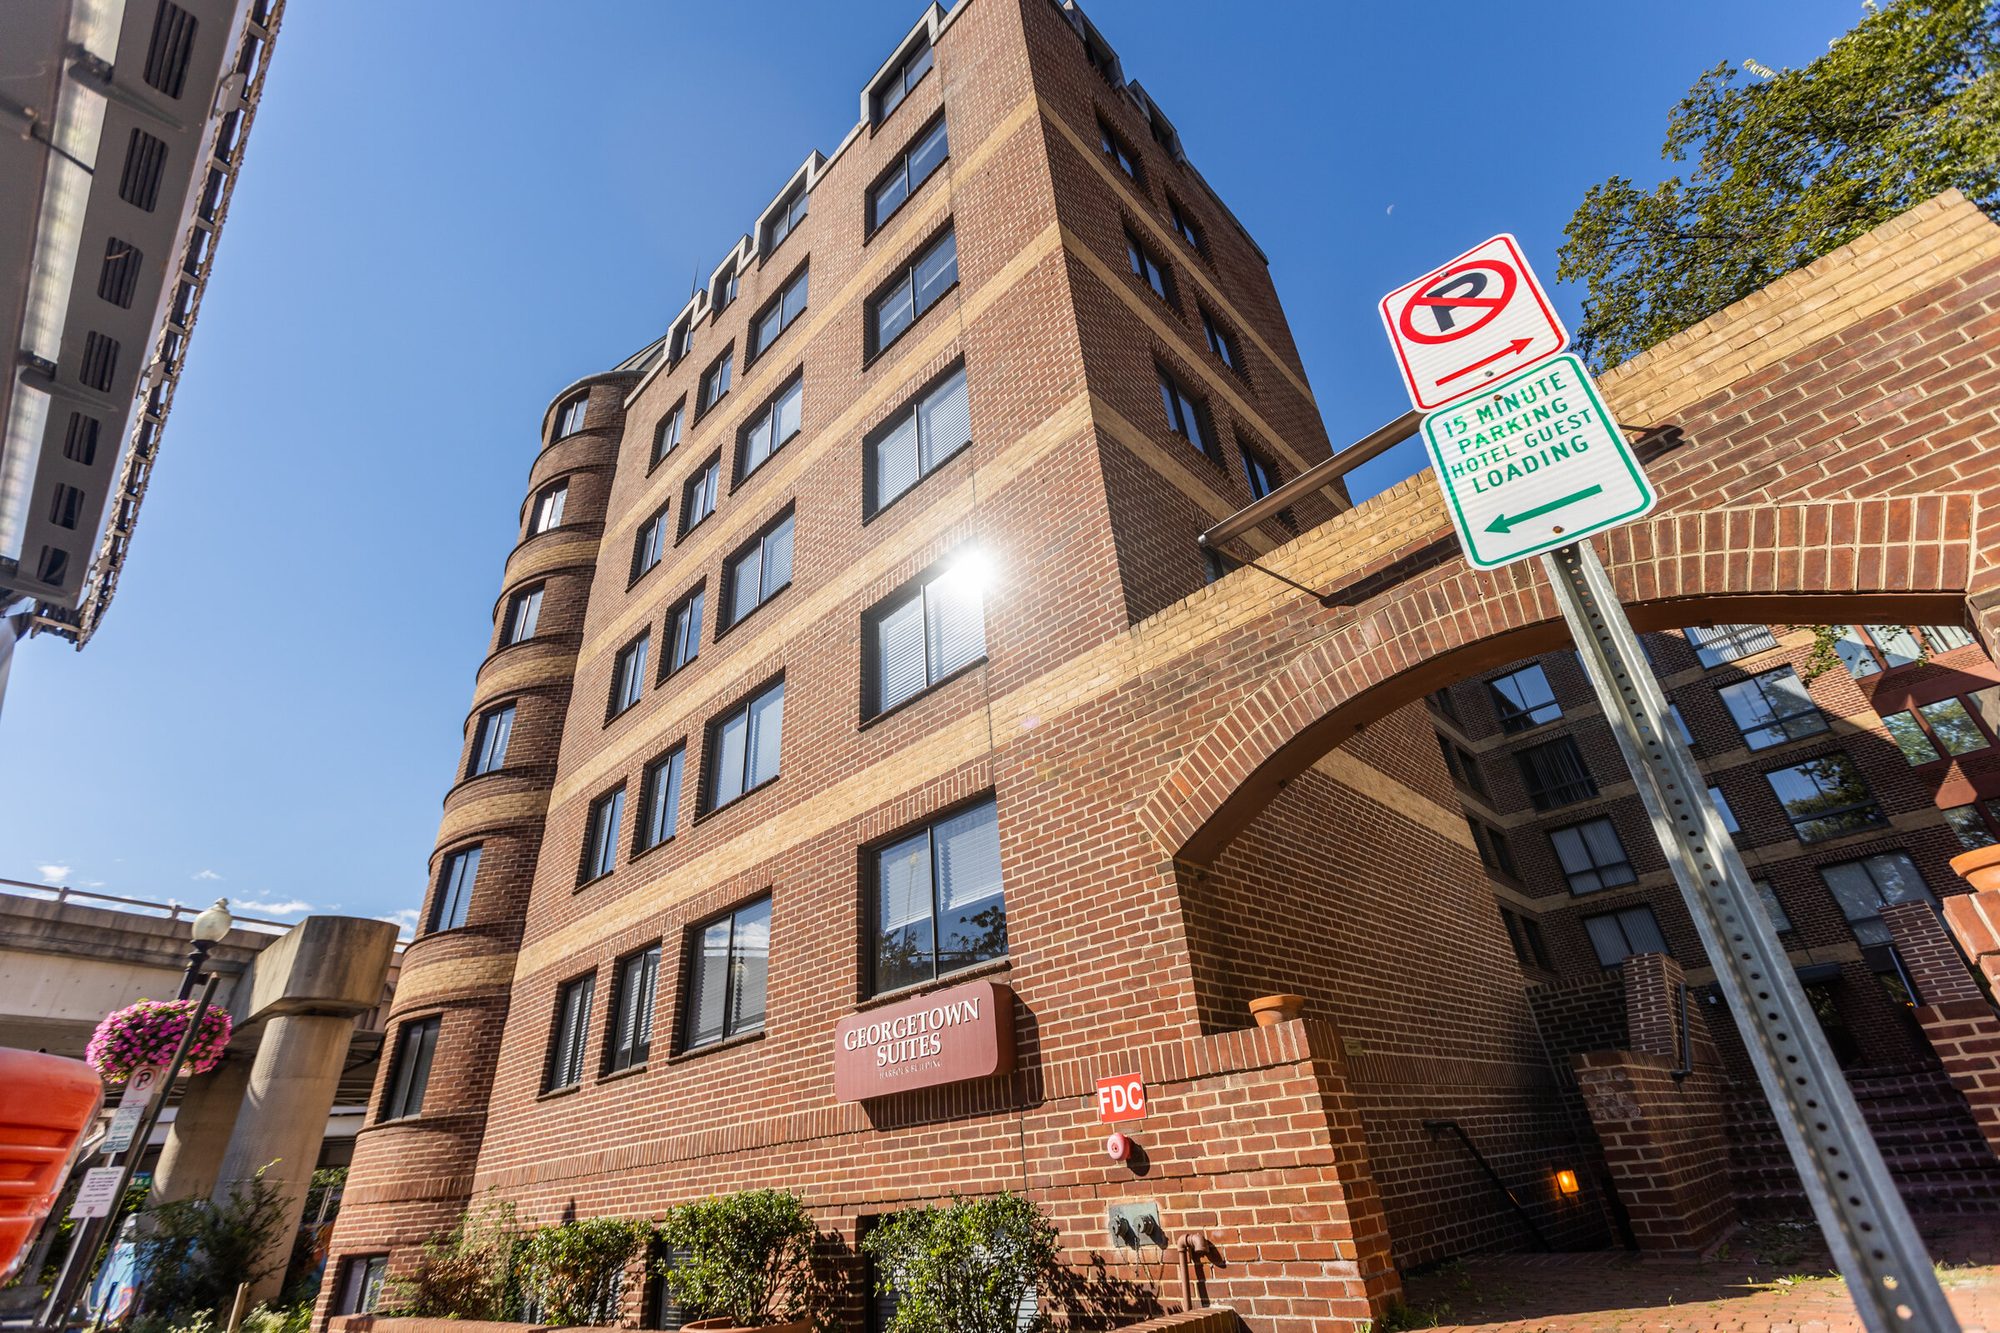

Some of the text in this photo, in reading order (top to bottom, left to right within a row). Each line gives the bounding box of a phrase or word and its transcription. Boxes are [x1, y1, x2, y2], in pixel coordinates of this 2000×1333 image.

[1426, 272, 1488, 332] P
[1443, 371, 1567, 438] 15 MINUTE
[1457, 397, 1569, 455] PARKING
[1451, 408, 1592, 479] HOTEL GUEST
[1472, 434, 1590, 494] LOADING
[844, 997, 980, 1051] GEORGETOWN
[876, 1032, 942, 1067] SUITES
[1098, 1081, 1143, 1115] FDC
